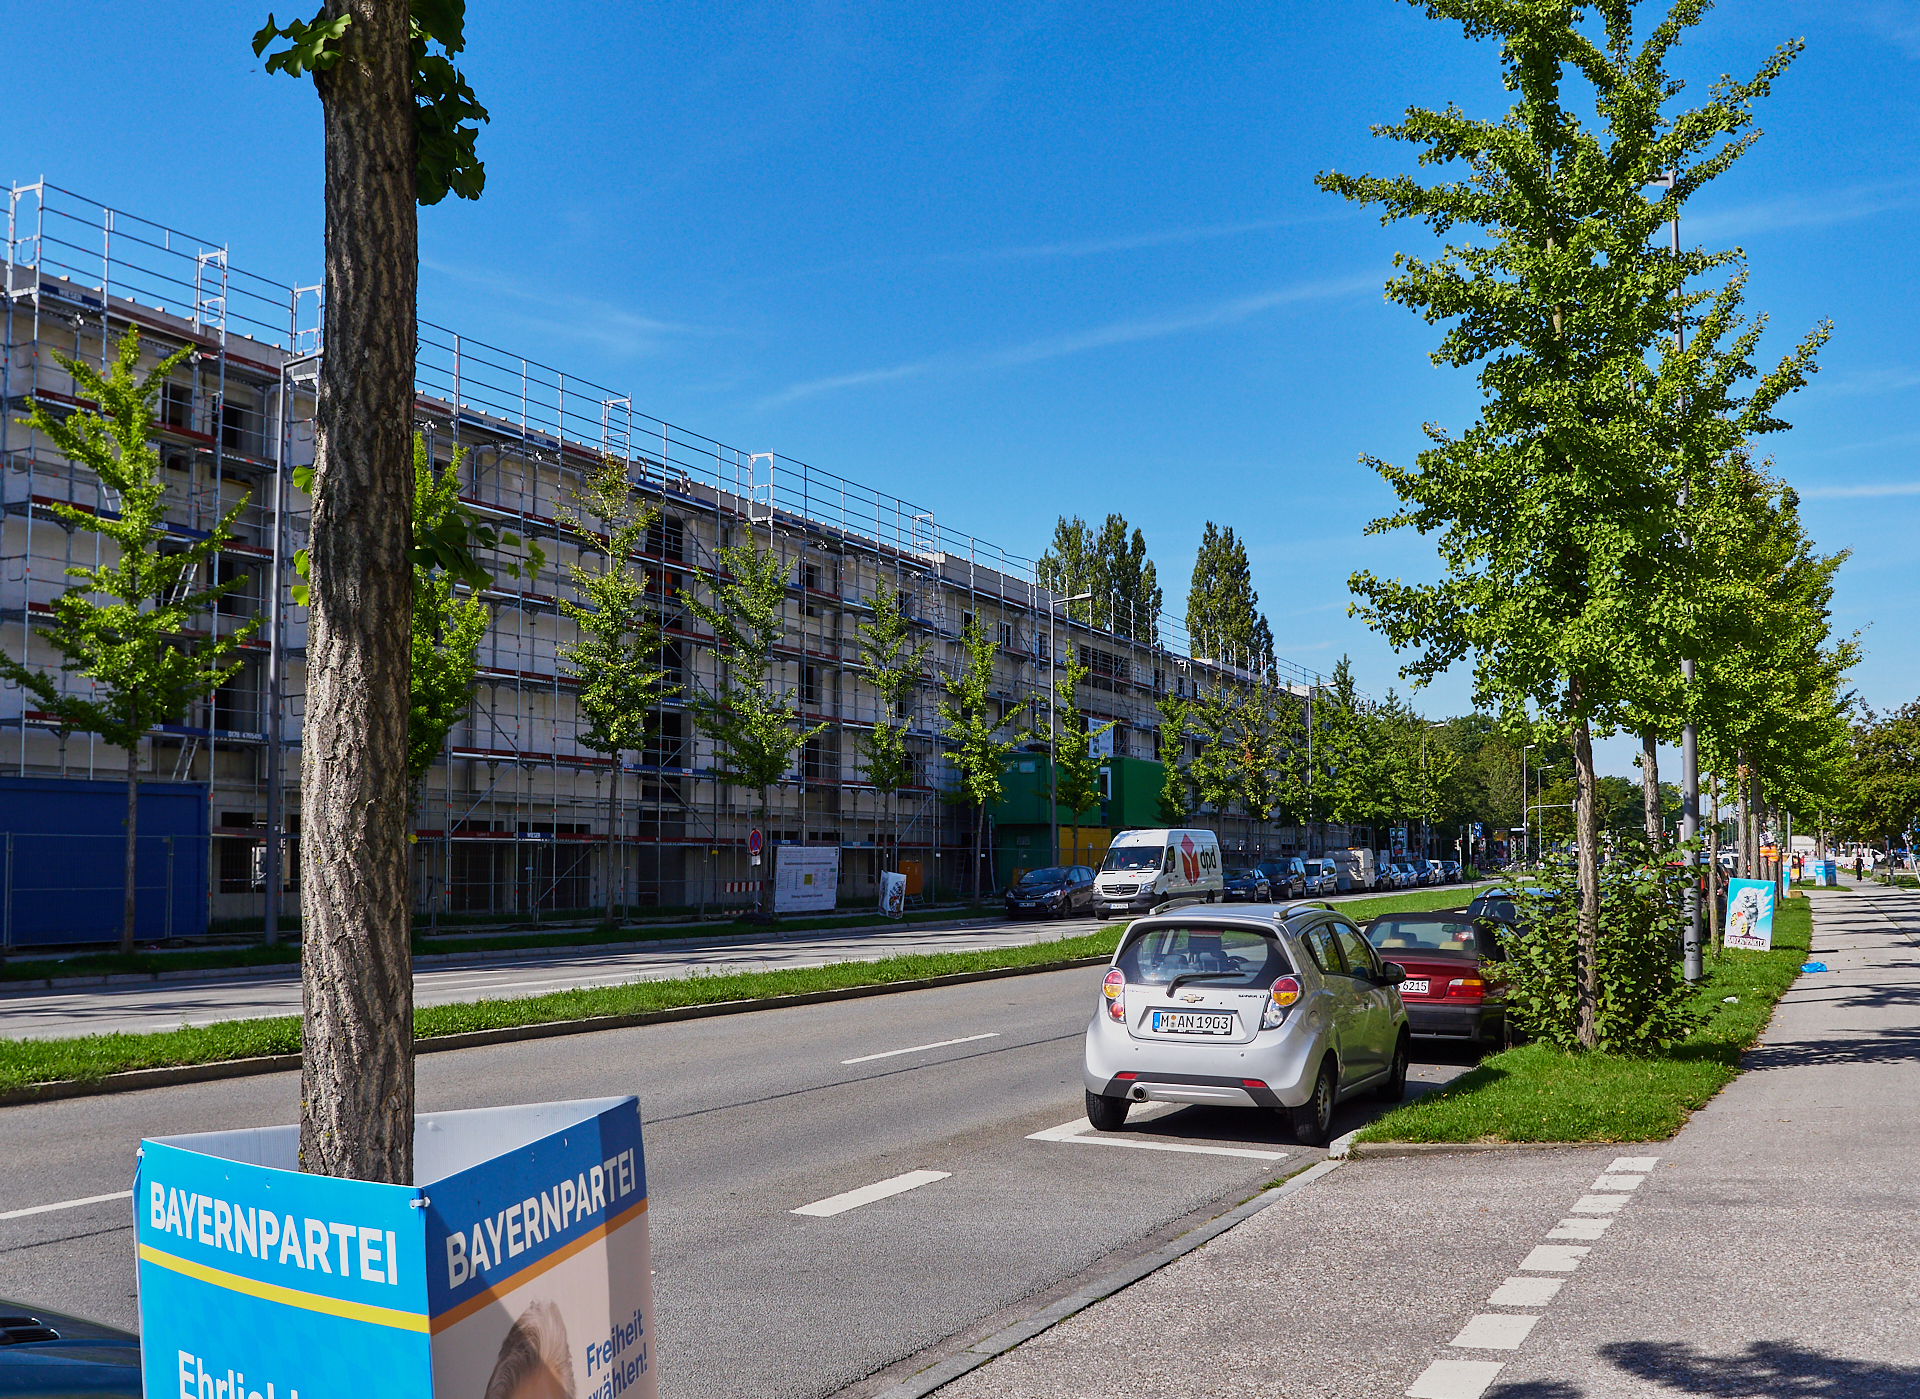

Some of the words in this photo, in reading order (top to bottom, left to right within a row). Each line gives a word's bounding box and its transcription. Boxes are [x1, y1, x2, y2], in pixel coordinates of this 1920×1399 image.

[1200, 845, 1217, 874] dpd
[1402, 981, 1427, 991] 6215
[1161, 1015, 1169, 1027] M
[1178, 1015, 1194, 1028] AN
[1196, 1016, 1229, 1029] 1903
[150, 1181, 398, 1285] BAYERNPARTEI
[446, 1147, 636, 1289] BAYERNPARTEI
[586, 1308, 644, 1377] Freiheit
